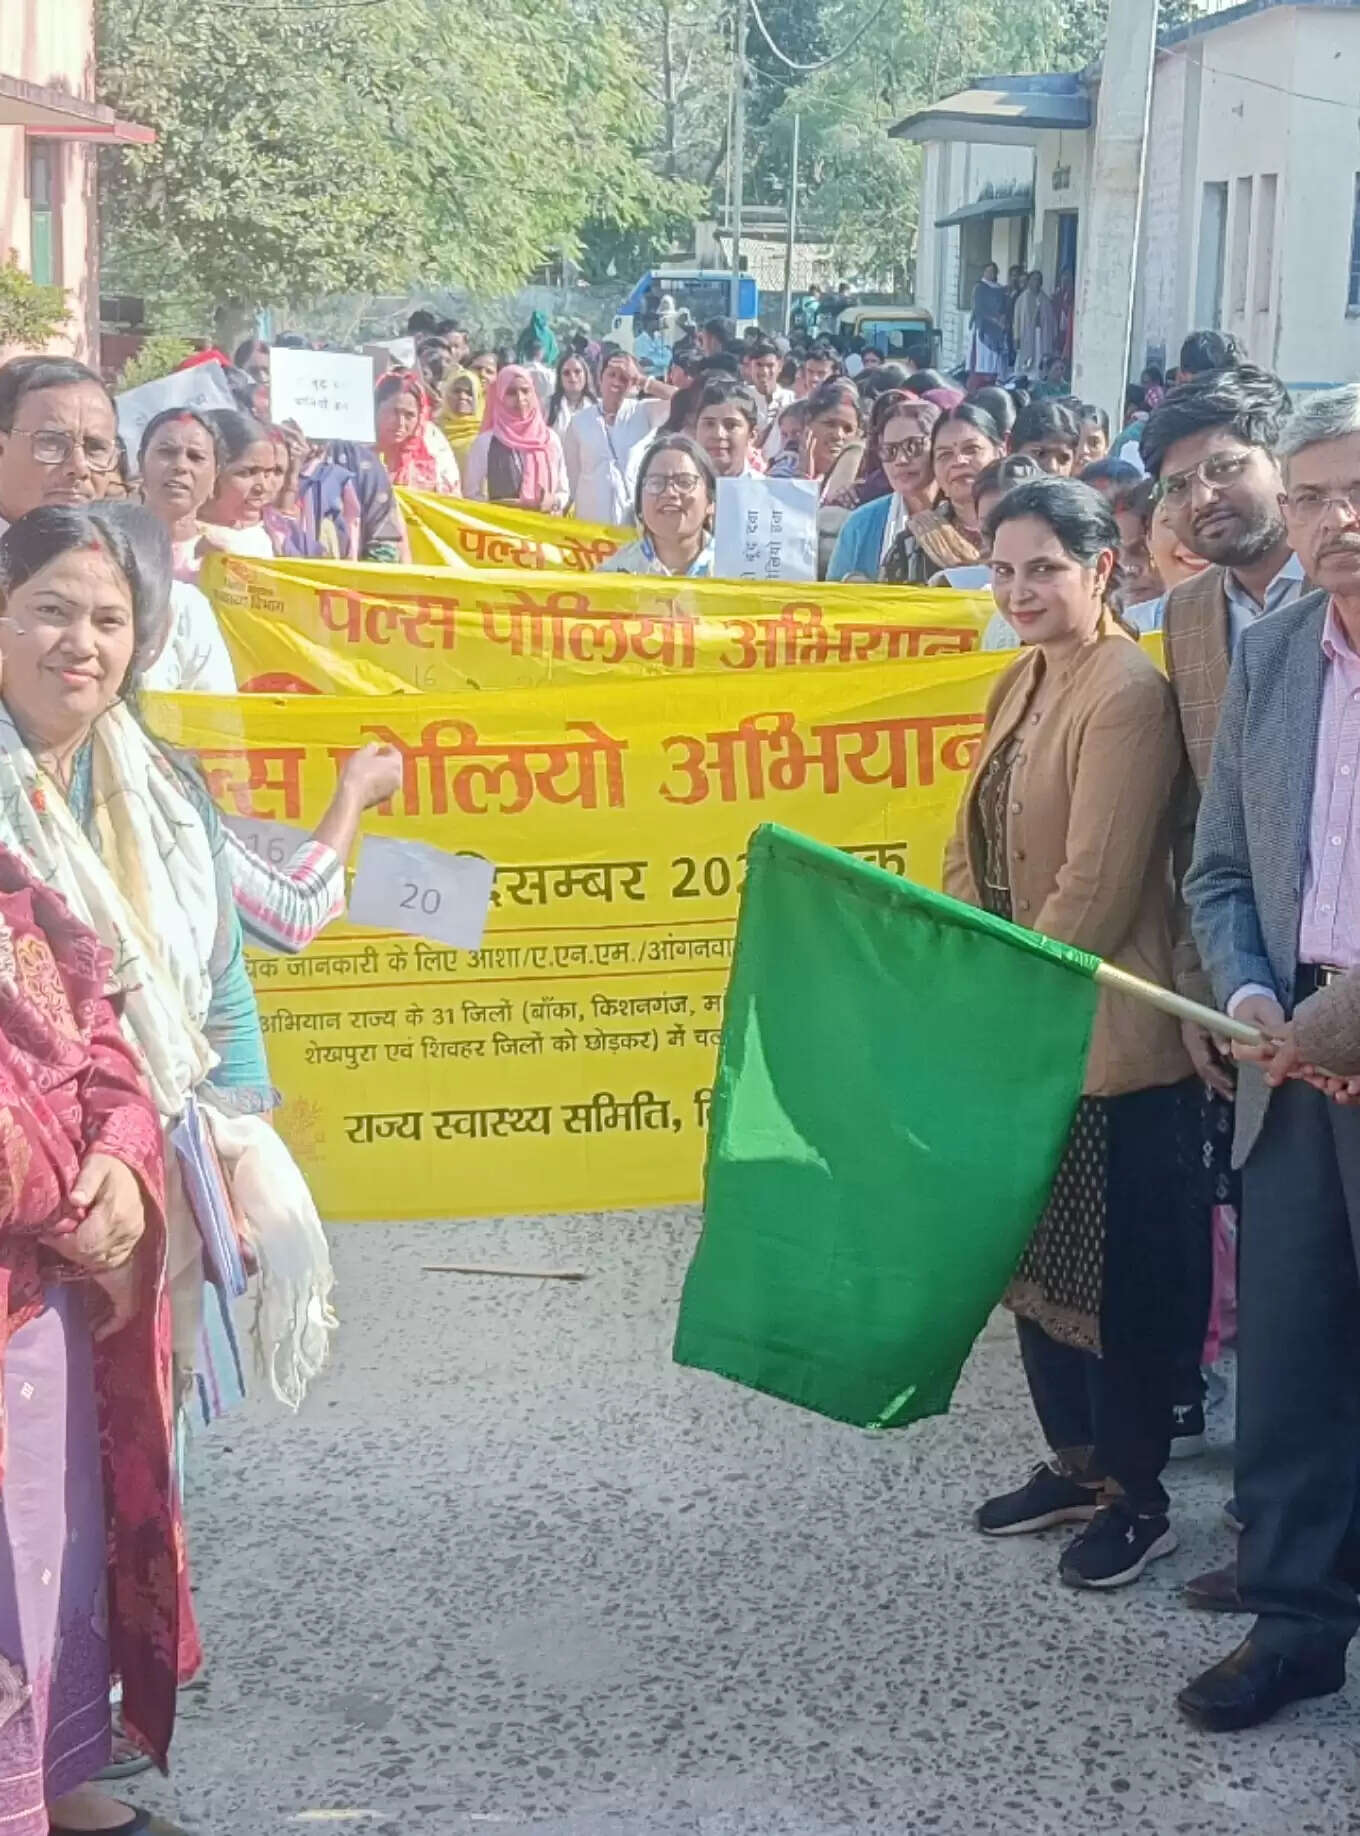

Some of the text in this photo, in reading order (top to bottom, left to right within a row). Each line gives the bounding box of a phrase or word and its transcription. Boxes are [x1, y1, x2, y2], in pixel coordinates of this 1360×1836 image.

[315, 588, 460, 650] पल्स
[476, 589, 701, 669] पोलियो
[399, 883, 442, 915] 20
[287, 945, 380, 977] जानकारी
[388, 944, 408, 972] के
[414, 942, 457, 972] लिए
[348, 1009, 397, 1029] राज्य
[406, 1002, 424, 1026] के
[431, 1008, 454, 1025] 31
[304, 1039, 378, 1070] शेखपुरा
[384, 1036, 414, 1060] एवं
[420, 1034, 486, 1059] शिवहर
[551, 1028, 578, 1053] को
[343, 1111, 424, 1144] राज्य
[431, 1104, 552, 1140] स्वास्थ्य
[560, 1089, 683, 1135] समिति,
